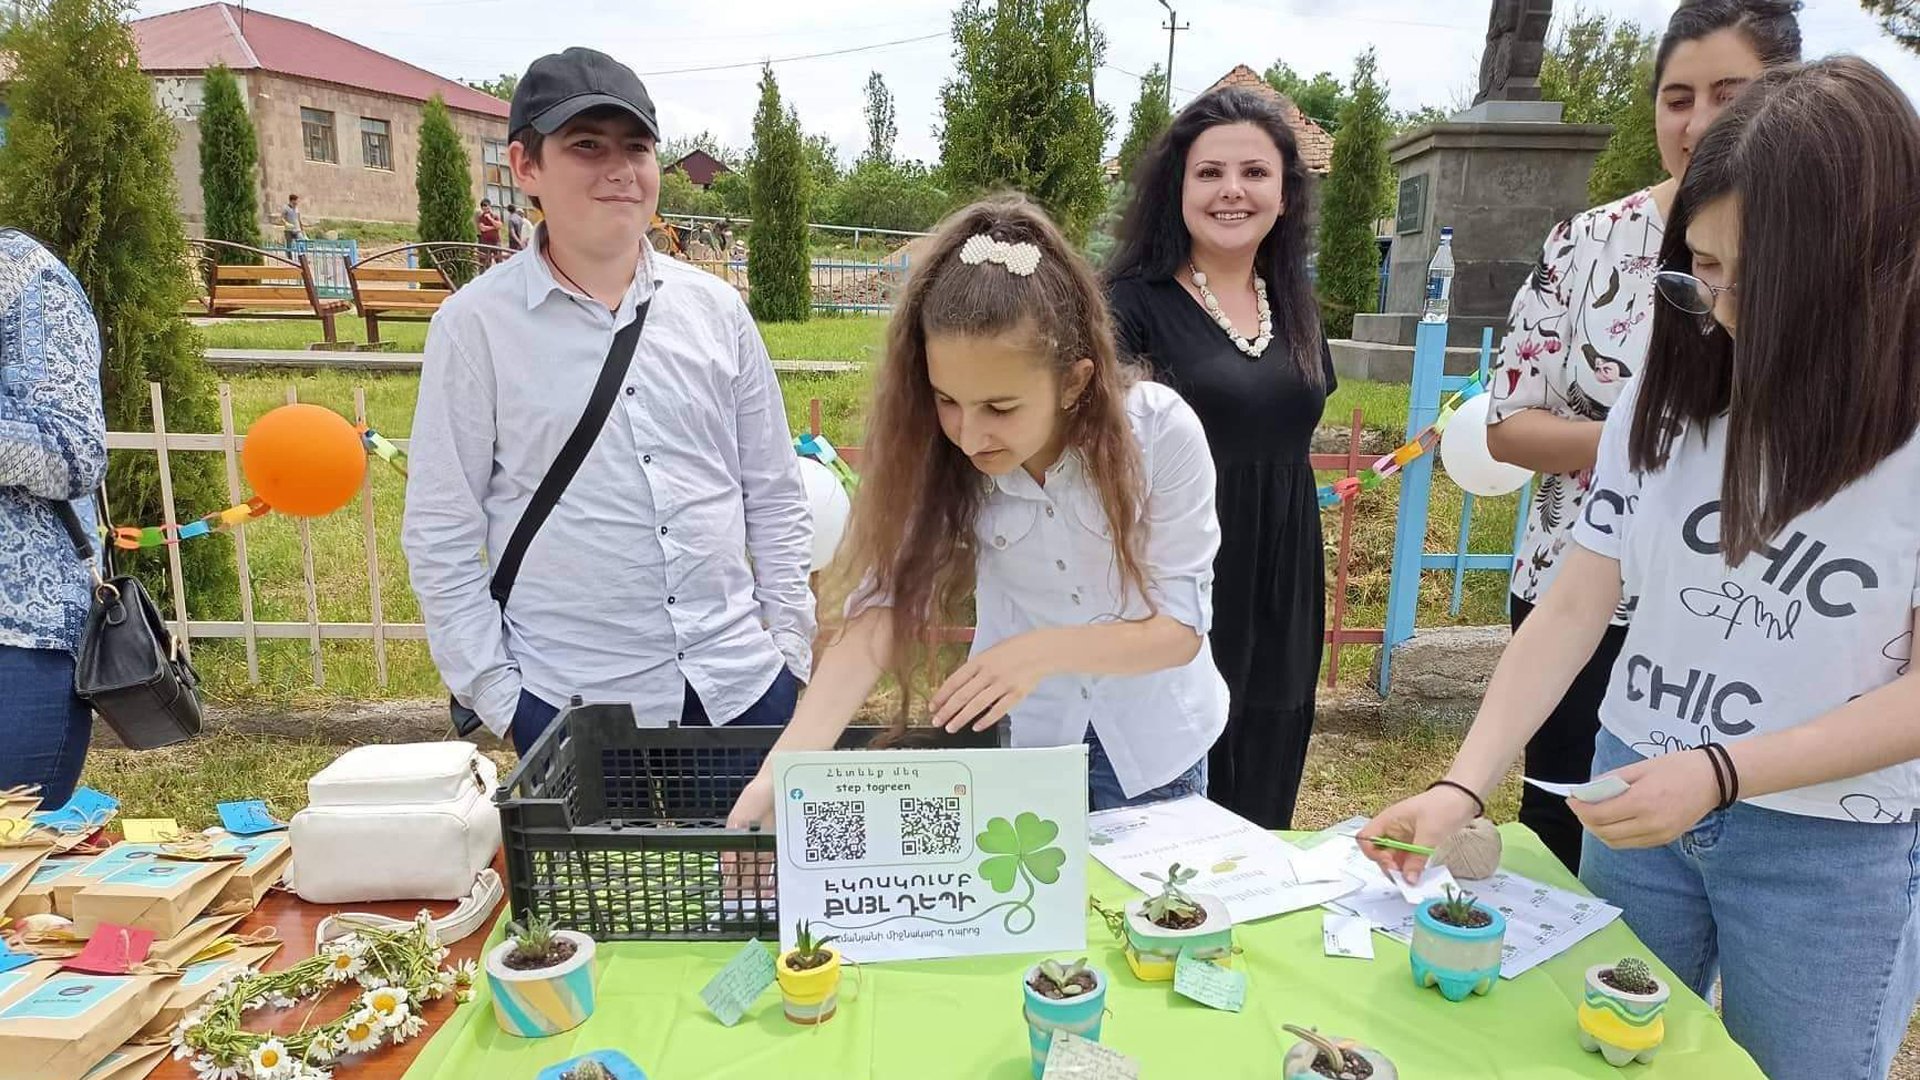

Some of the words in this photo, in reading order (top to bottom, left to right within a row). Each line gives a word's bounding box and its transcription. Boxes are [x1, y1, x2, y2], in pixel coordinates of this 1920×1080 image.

[1627, 654, 1763, 735] CHIC
[893, 767, 919, 778] մեզ
[835, 782, 911, 794] step.togreen
[825, 873, 972, 893] ԷԿՈԱԿՈՒՄԲ
[824, 894, 890, 919] ՔԱՅԼ
[897, 891, 976, 916] ԴԵՊԻ
